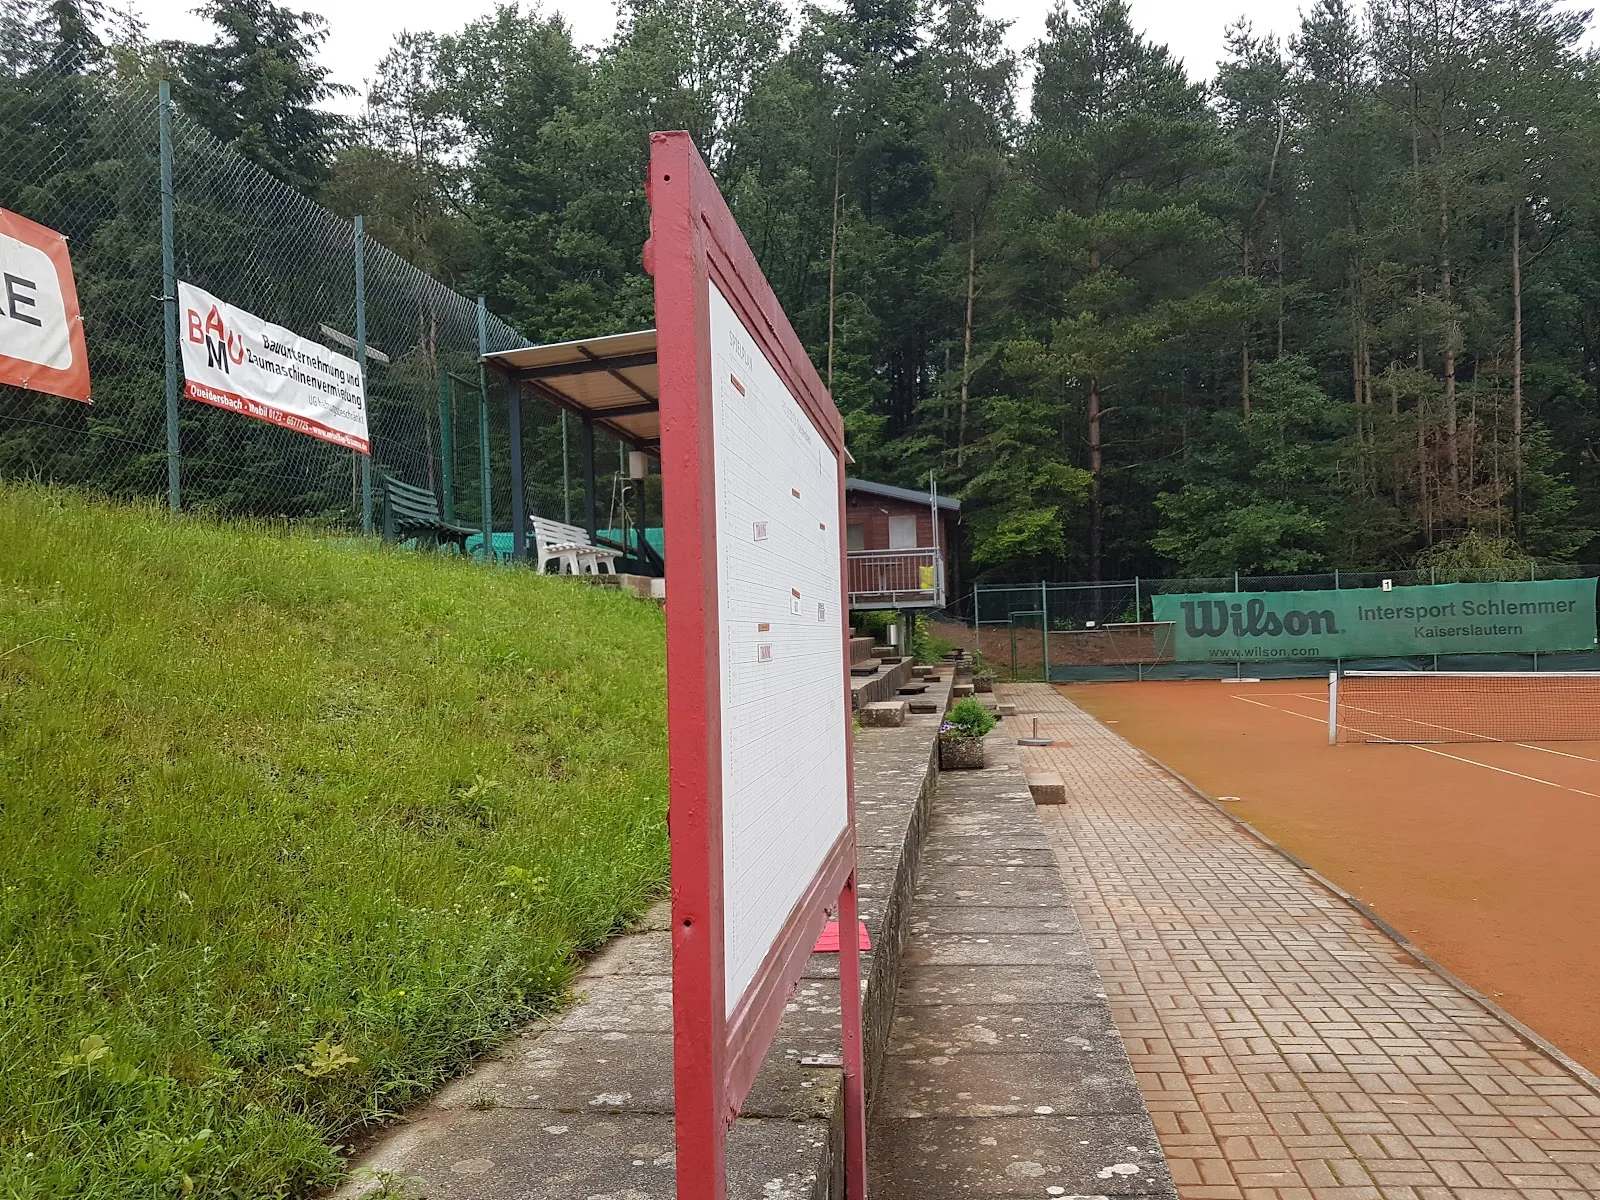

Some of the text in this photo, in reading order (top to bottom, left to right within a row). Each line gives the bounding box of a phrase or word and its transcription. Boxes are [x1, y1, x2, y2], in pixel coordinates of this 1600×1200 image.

[0, 272, 42, 327] E
[262, 334, 360, 387] Bauunternehmung und
[245, 348, 362, 410] Baumaschinenvermietung
[190, 385, 242, 411] Queidersbach
[249, 402, 268, 417] Mobil
[1180, 598, 1340, 638] Wilson
[1358, 599, 1576, 622] Intersport Schlemmer
[1414, 624, 1523, 638] Kaiserslautern
[1209, 646, 1320, 657] www.wilson.com
